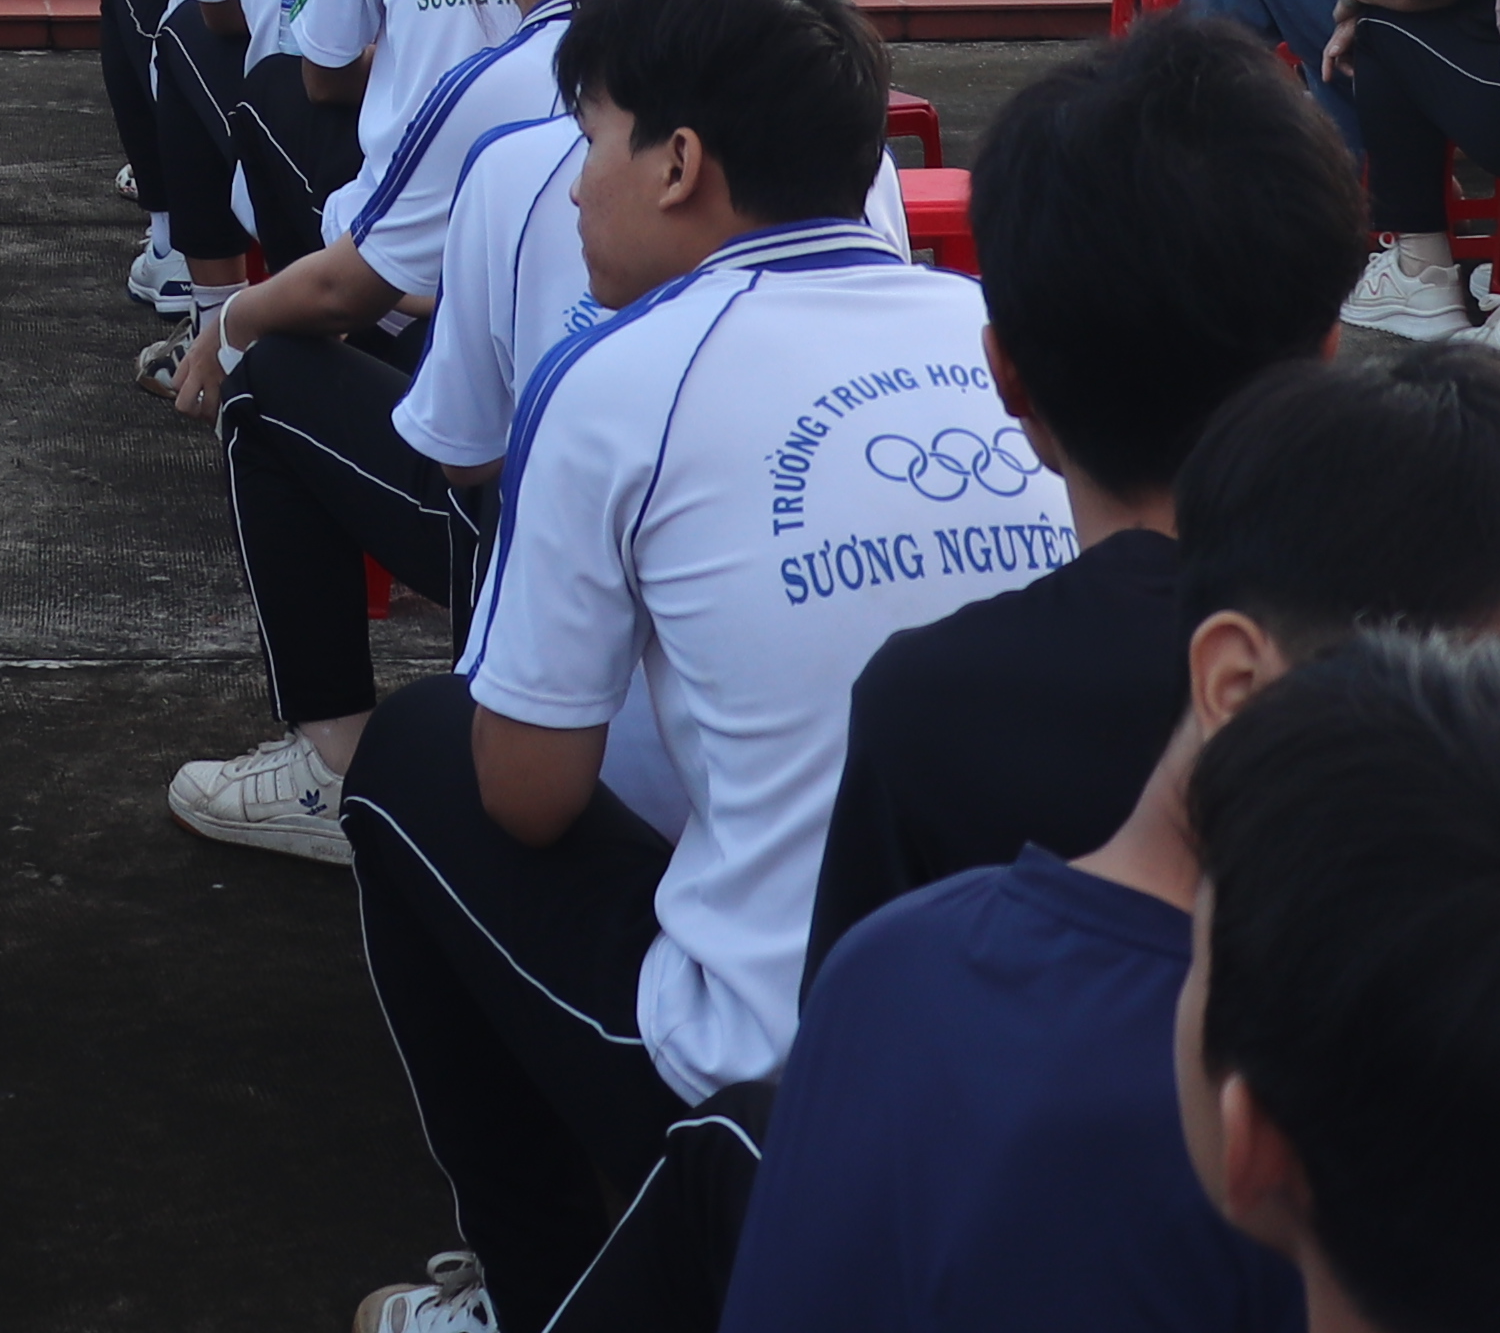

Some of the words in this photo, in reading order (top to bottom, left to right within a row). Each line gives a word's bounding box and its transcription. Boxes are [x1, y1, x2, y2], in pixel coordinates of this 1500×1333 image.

[763, 412, 830, 536] TRƯỜNG
[812, 366, 918, 420] TRUNG
[925, 363, 990, 394] HỌC
[779, 530, 925, 607] SƯƠNG
